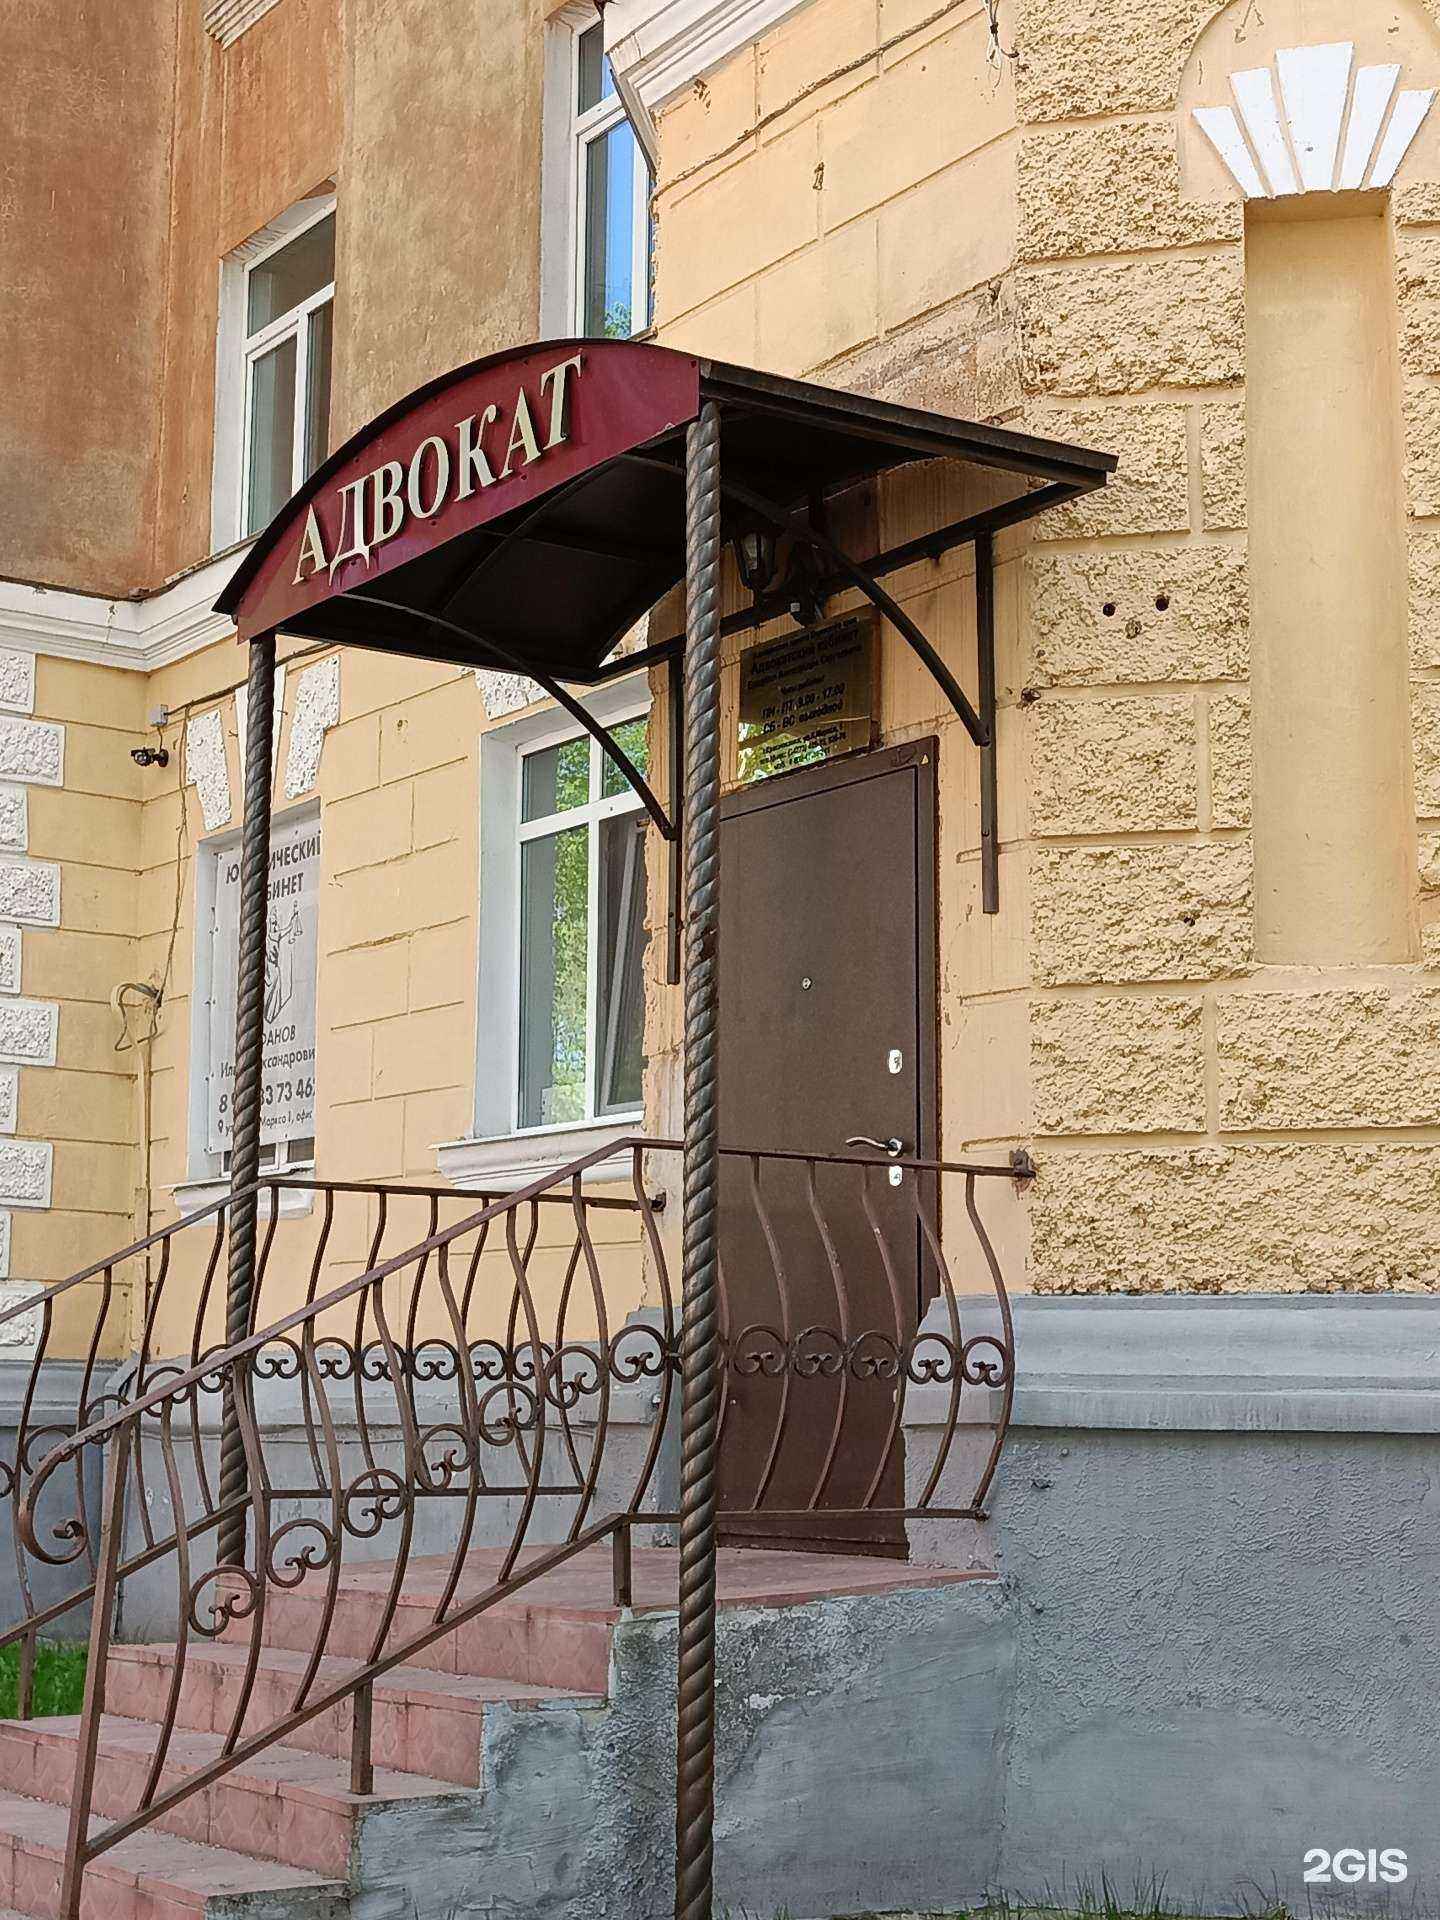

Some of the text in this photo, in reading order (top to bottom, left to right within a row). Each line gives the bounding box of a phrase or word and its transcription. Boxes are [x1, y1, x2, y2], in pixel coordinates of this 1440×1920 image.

[292, 353, 582, 587] АДВОКАТ
[266, 872, 304, 901] БИНЕТ
[262, 1024, 296, 1047] АНОВ
[219, 1094, 228, 1114] 8
[277, 1081, 293, 1103] 73
[296, 1077, 315, 1099] 46
